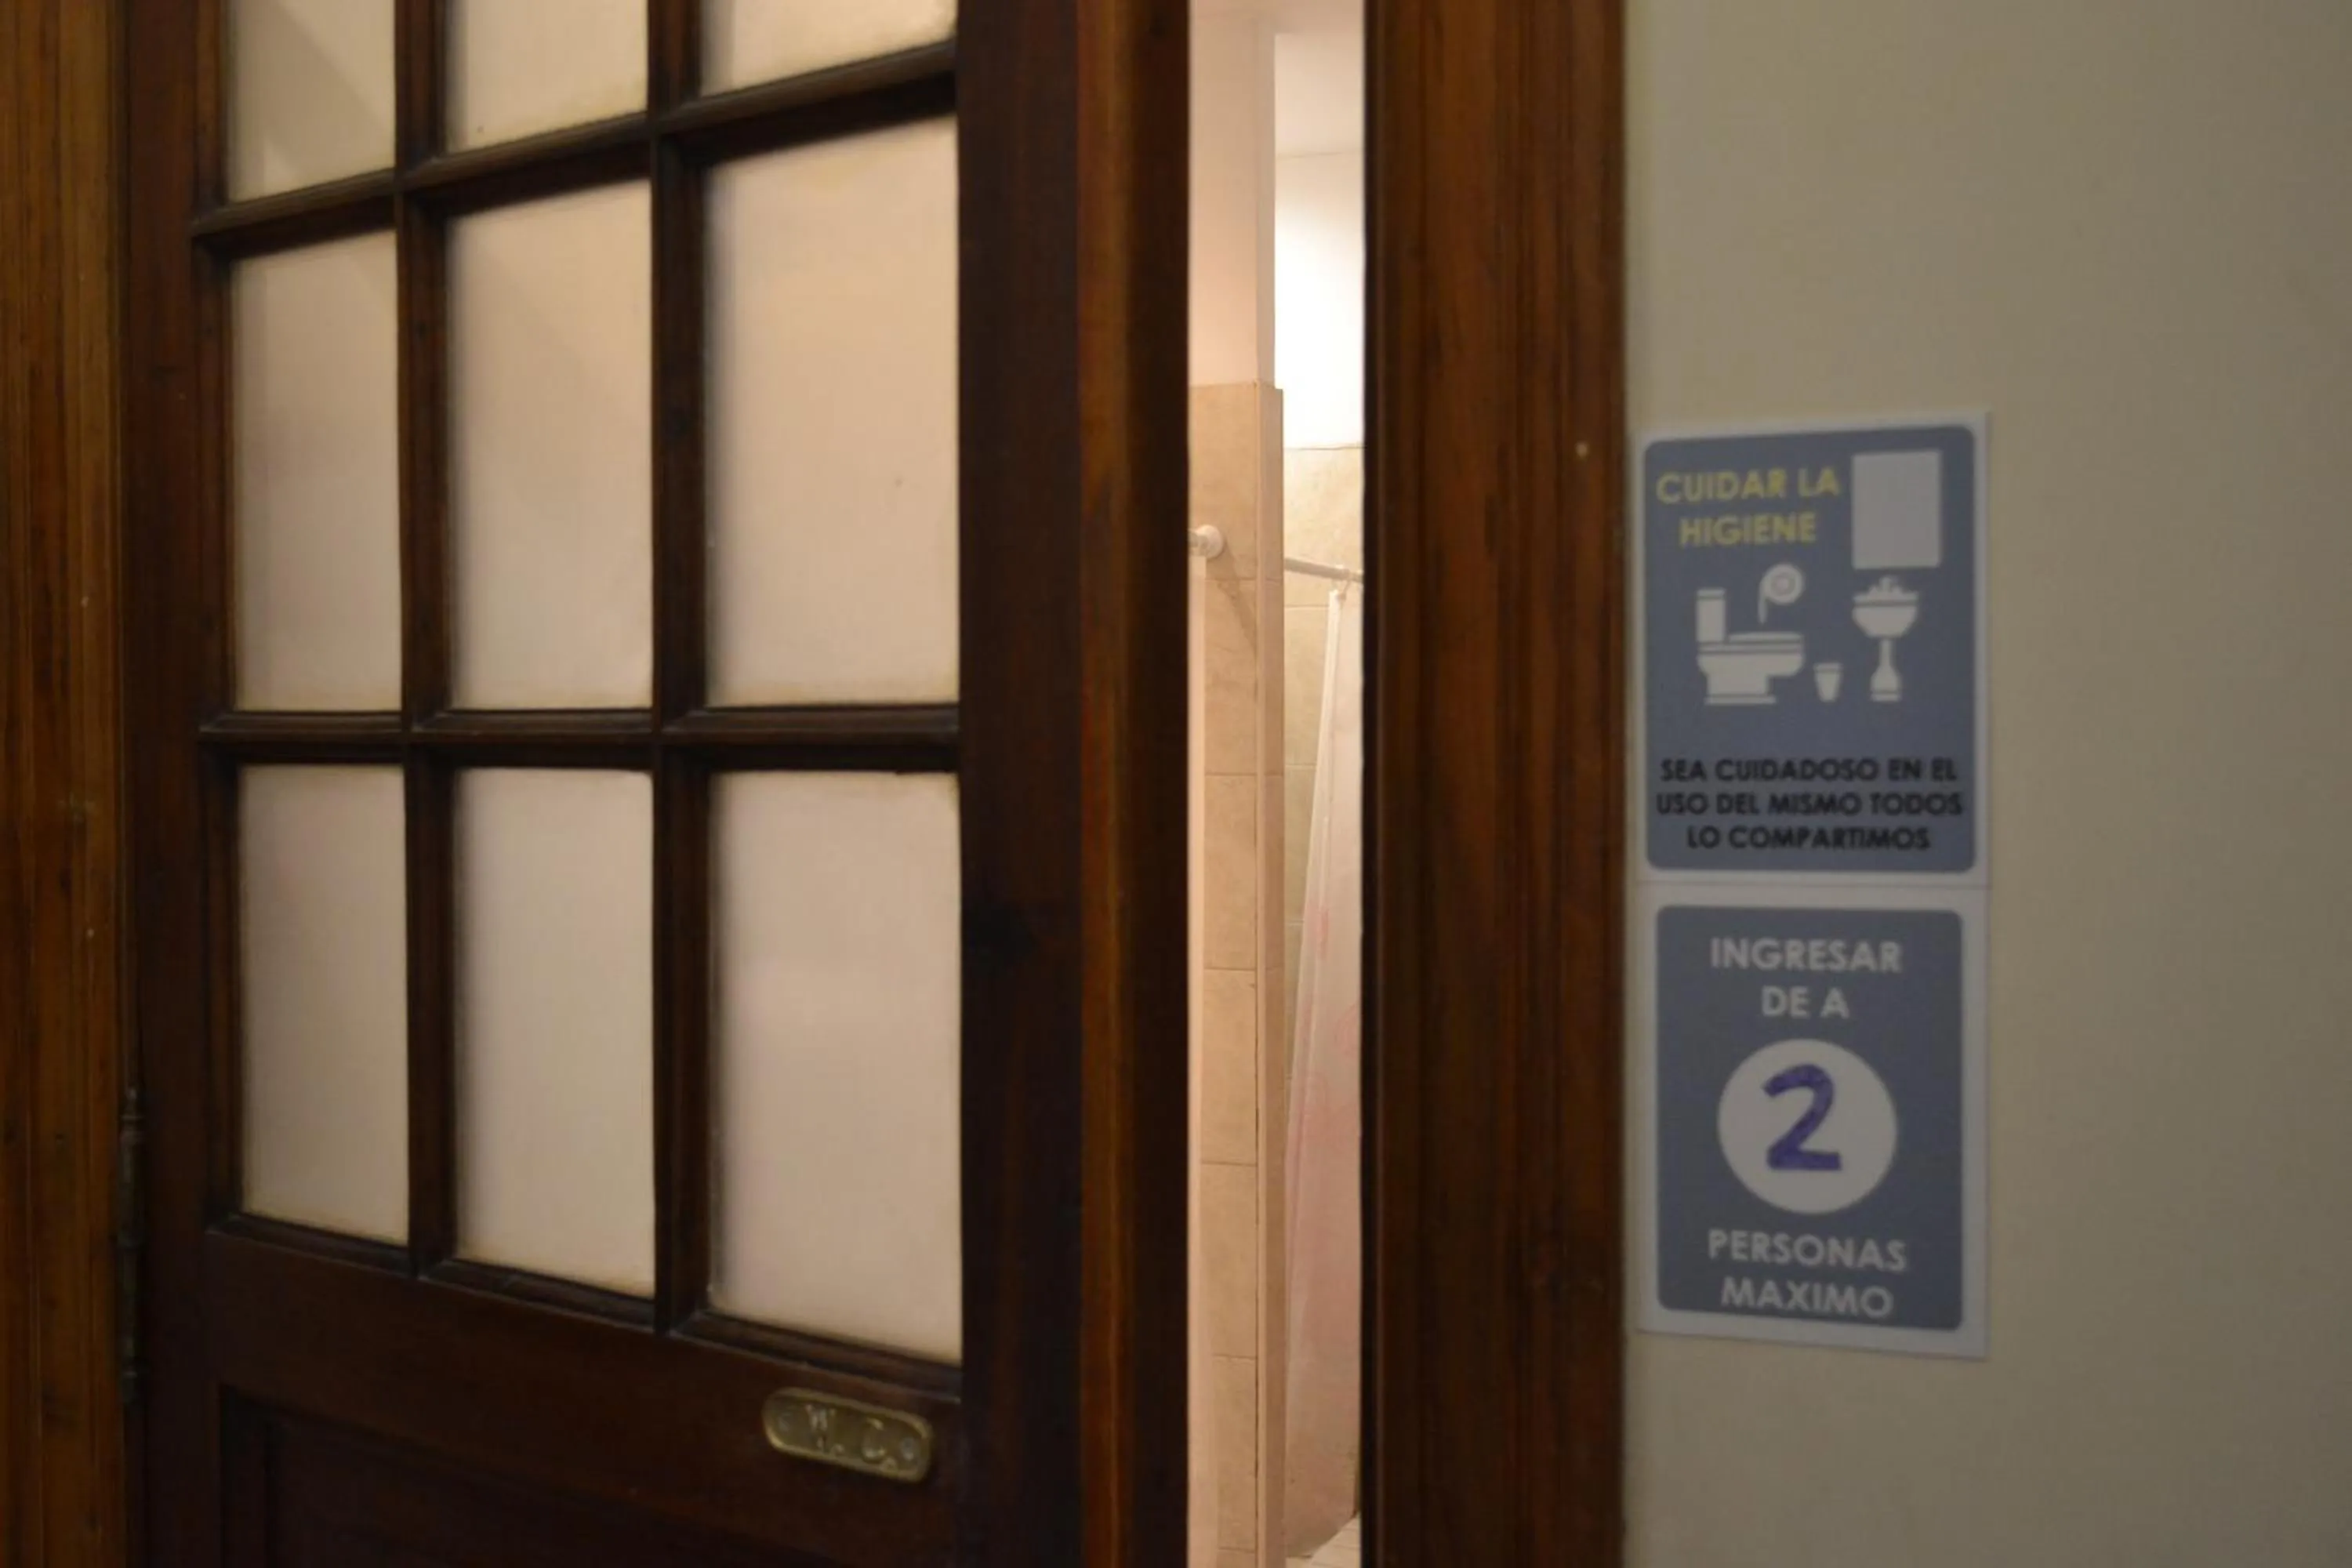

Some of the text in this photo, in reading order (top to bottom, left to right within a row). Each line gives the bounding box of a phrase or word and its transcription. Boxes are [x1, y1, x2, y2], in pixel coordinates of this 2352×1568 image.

[1657, 467, 1840, 504] CUIDAR LA
[1679, 512, 1817, 547] HIGIENE
[1661, 758, 1957, 782] SEA CUIDADOSO EN EL
[1657, 792, 1964, 816] USO DEL MISMO TODOS
[1687, 826, 1929, 850] LO COMPARTIMOS
[1710, 937, 1903, 973] INGRESAR
[1761, 985, 1850, 1018] DE A
[1762, 1063, 1842, 1171] 2
[1708, 1229, 1907, 1272] PERSONAS
[1721, 1276, 1895, 1319] MAXIMO
